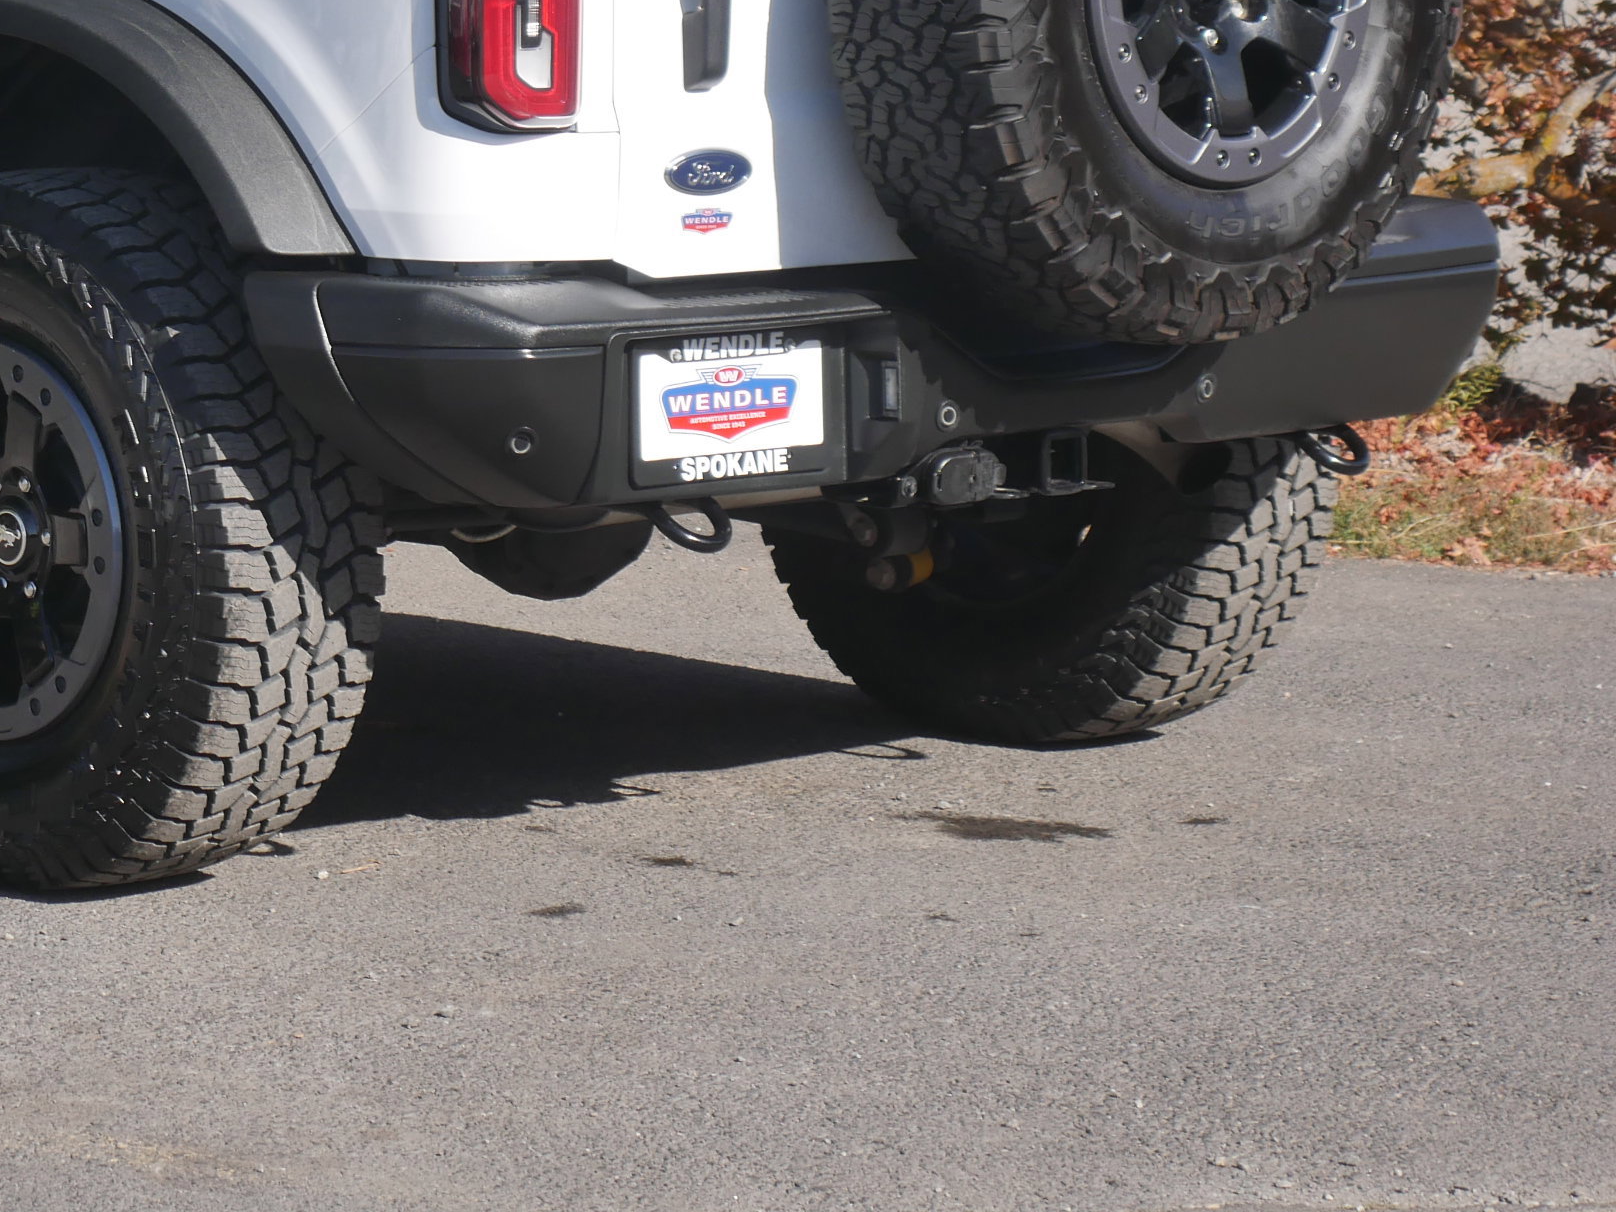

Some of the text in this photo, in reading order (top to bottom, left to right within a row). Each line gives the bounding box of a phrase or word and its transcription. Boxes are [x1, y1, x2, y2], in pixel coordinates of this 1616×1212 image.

[687, 161, 734, 186] Ford
[685, 216, 729, 224] WENDLE
[683, 331, 785, 362] WENDLE
[668, 386, 787, 413] WENDLE
[690, 414, 728, 424] AUTOMOTIVE
[712, 422, 731, 430] SINCE
[681, 448, 789, 482] SPOKANE
